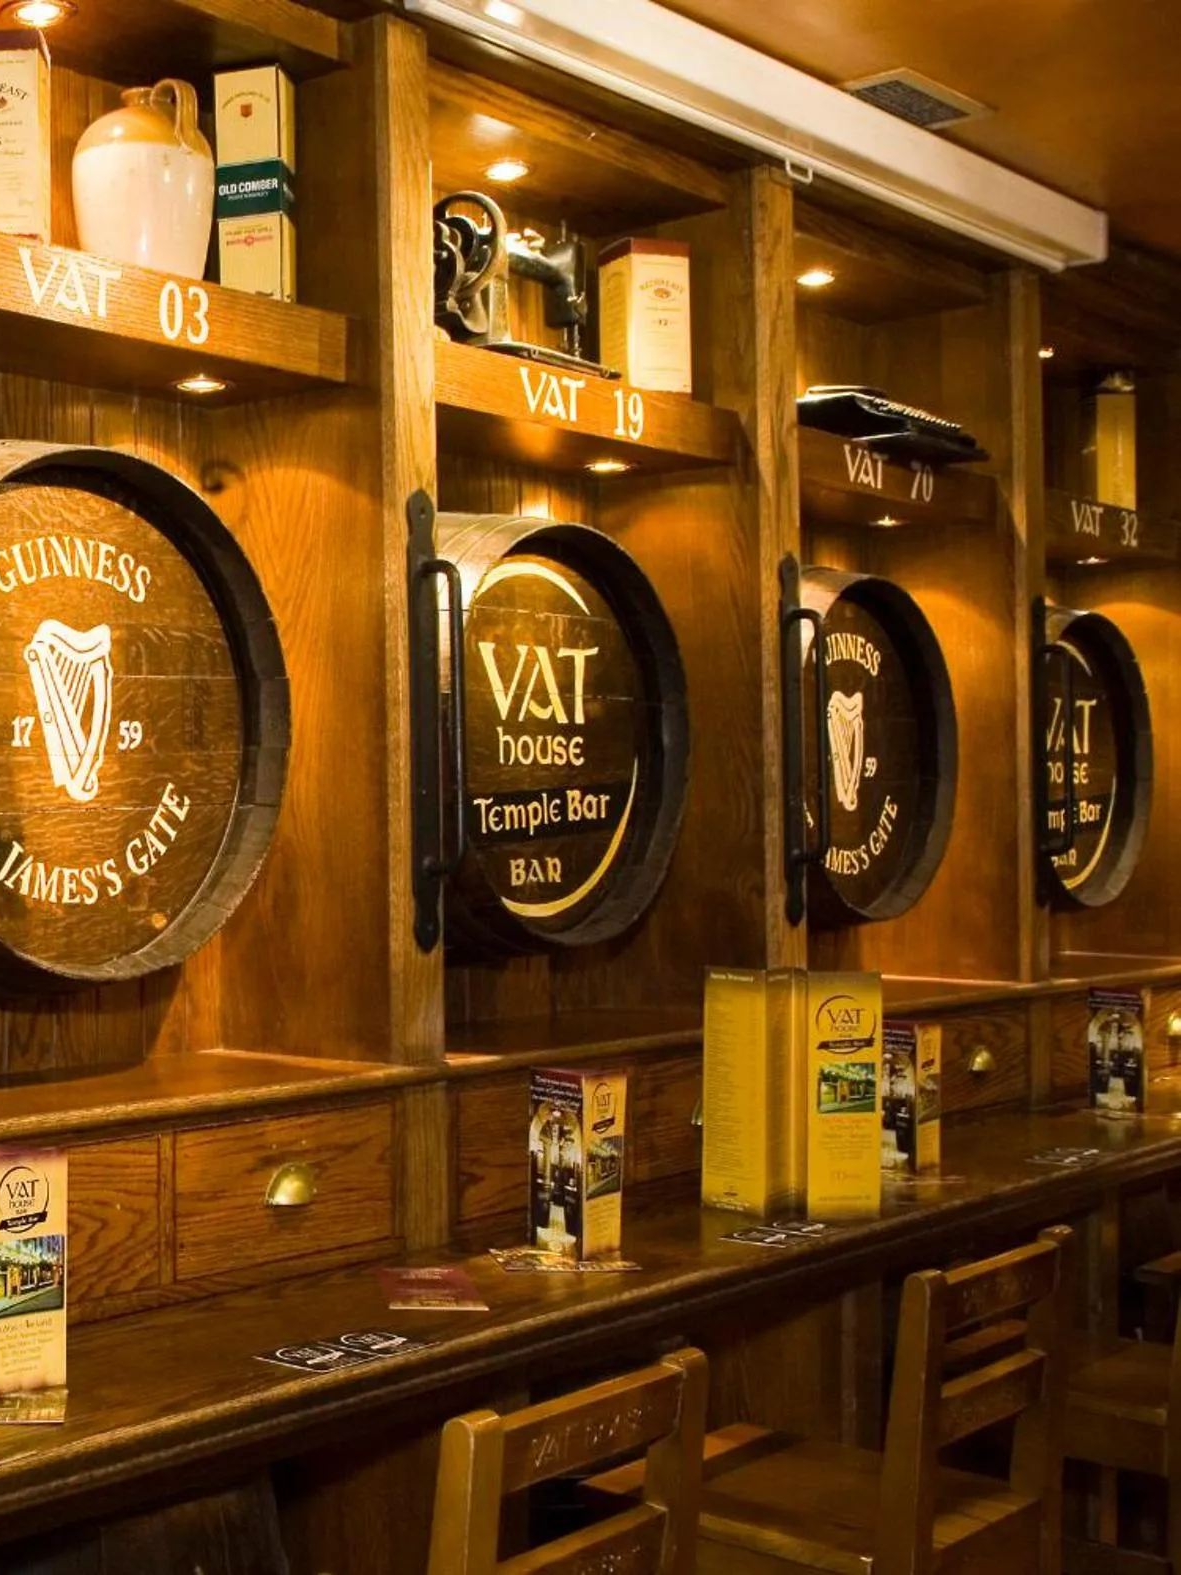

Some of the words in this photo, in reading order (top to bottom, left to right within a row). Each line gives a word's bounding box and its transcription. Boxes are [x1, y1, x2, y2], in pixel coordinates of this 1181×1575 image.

[218, 183, 237, 196] OLD
[238, 177, 279, 193] COMBER
[19, 246, 123, 318] VAT
[159, 280, 210, 345] 03
[519, 366, 586, 422] VAT
[613, 389, 645, 441] 19
[842, 444, 889, 489] VAT
[910, 460, 934, 503] 70
[1071, 500, 1104, 538] VAT
[1120, 511, 1139, 549] 32
[478, 641, 600, 725] VAT
[11, 716, 35, 748] 17
[118, 720, 143, 751] 59
[496, 726, 585, 766] house
[864, 757, 878, 778] 59
[125, 782, 191, 876] GATE
[473, 792, 562, 836] Temple
[567, 789, 611, 821] Bar
[869, 795, 899, 856] GATE
[1079, 800, 1102, 824] Bar
[509, 856, 562, 887] BAR
[827, 1007, 866, 1025] VAT
[5, 1178, 40, 1200] VAT
